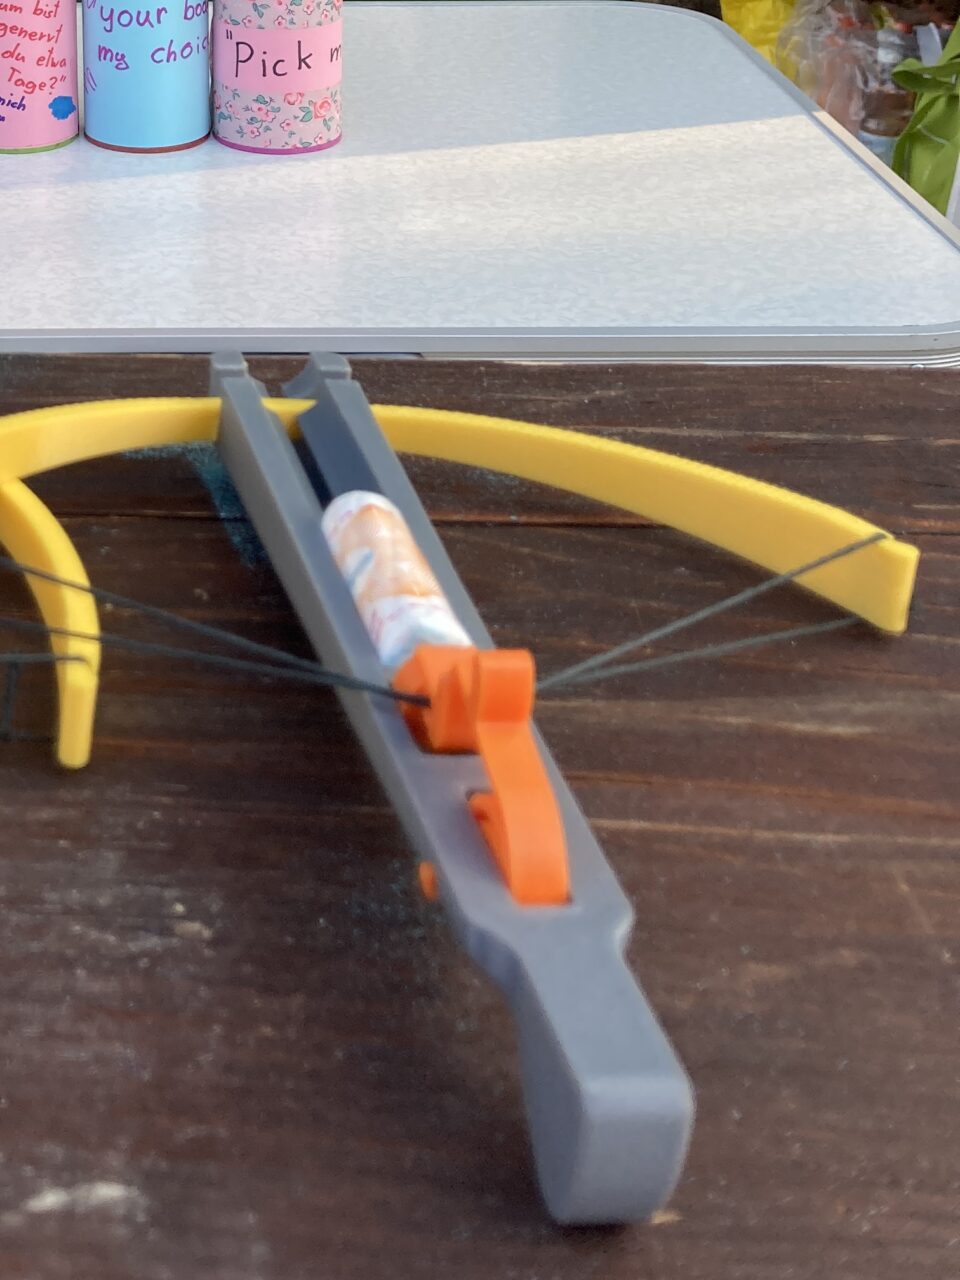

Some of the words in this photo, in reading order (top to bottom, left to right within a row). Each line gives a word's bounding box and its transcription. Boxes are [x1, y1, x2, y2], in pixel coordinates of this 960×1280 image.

[32, 0, 60, 19] bist
[100, 4, 168, 32] your
[1, 43, 25, 63] du
[36, 47, 66, 68] etwa
[98, 44, 129, 70] my
[151, 34, 209, 64] choic
[330, 43, 341, 63] m
